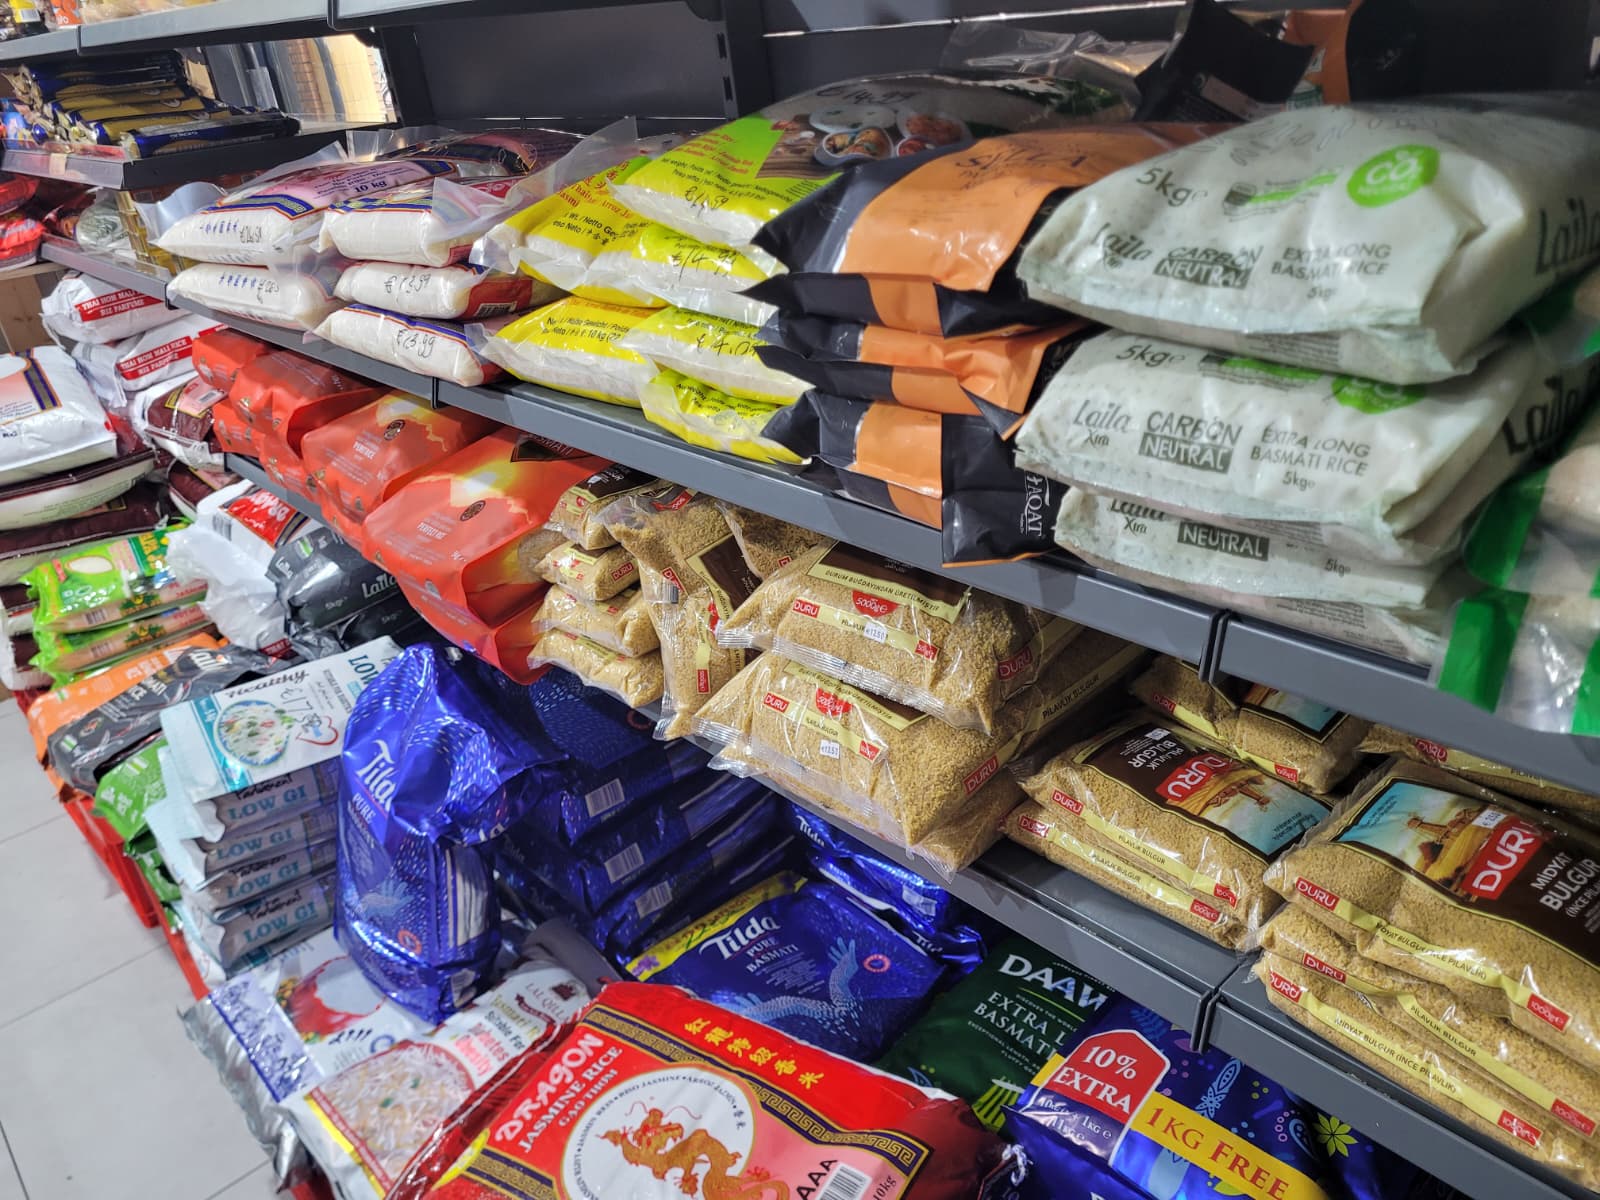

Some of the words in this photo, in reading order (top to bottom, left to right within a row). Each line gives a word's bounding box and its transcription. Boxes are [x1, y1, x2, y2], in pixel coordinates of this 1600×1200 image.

[355, 184, 369, 193] 10
[371, 180, 387, 190] kg
[1168, 245, 1264, 267] CARBON
[1157, 259, 1250, 289] NEUTRAL
[1073, 399, 1132, 434] Laila
[1146, 410, 1243, 447] CARBON
[1144, 435, 1226, 472] NEUTRAL
[1261, 420, 1309, 449] EXTRA
[1315, 437, 1371, 459] LONG
[1250, 446, 1323, 470] BASMATI
[1326, 457, 1368, 477] RICE
[1182, 526, 1264, 558] NEUTRAL
[793, 600, 818, 616] DURU
[999, 649, 1032, 679] DURU
[765, 694, 788, 711] DURU
[1128, 740, 1177, 769] BULGUR
[966, 758, 998, 793] DURU
[1167, 755, 1227, 798] DURU
[227, 794, 277, 821] LOW
[283, 784, 309, 803] GI
[352, 792, 376, 825] PURE
[1054, 792, 1082, 814] DURU
[216, 834, 264, 860] LOW
[269, 827, 293, 845] GI
[796, 814, 825, 848] Tilda
[226, 873, 273, 899] LOW
[277, 861, 301, 880] GI
[1297, 880, 1337, 909] DURU
[243, 915, 289, 944] LOW
[294, 901, 318, 922] GI
[699, 916, 781, 960] Tilda
[745, 936, 780, 958] PURE
[745, 943, 799, 973] BASMATI
[1305, 955, 1345, 982] DURU
[987, 991, 1048, 1035] EXTRA
[973, 1002, 1057, 1061] BASMATI
[1362, 1031, 1397, 1057] BULGUR
[1443, 1026, 1478, 1058] BULGUR
[1083, 1045, 1137, 1080] 10%
[494, 1032, 605, 1142] DRAGON
[518, 1079, 587, 1154] JASMINE
[581, 1045, 623, 1082] RICE
[1053, 1066, 1132, 1115] EXTRA
[795, 1158, 838, 1200] AAA
[1207, 1139, 1290, 1200] FREE
